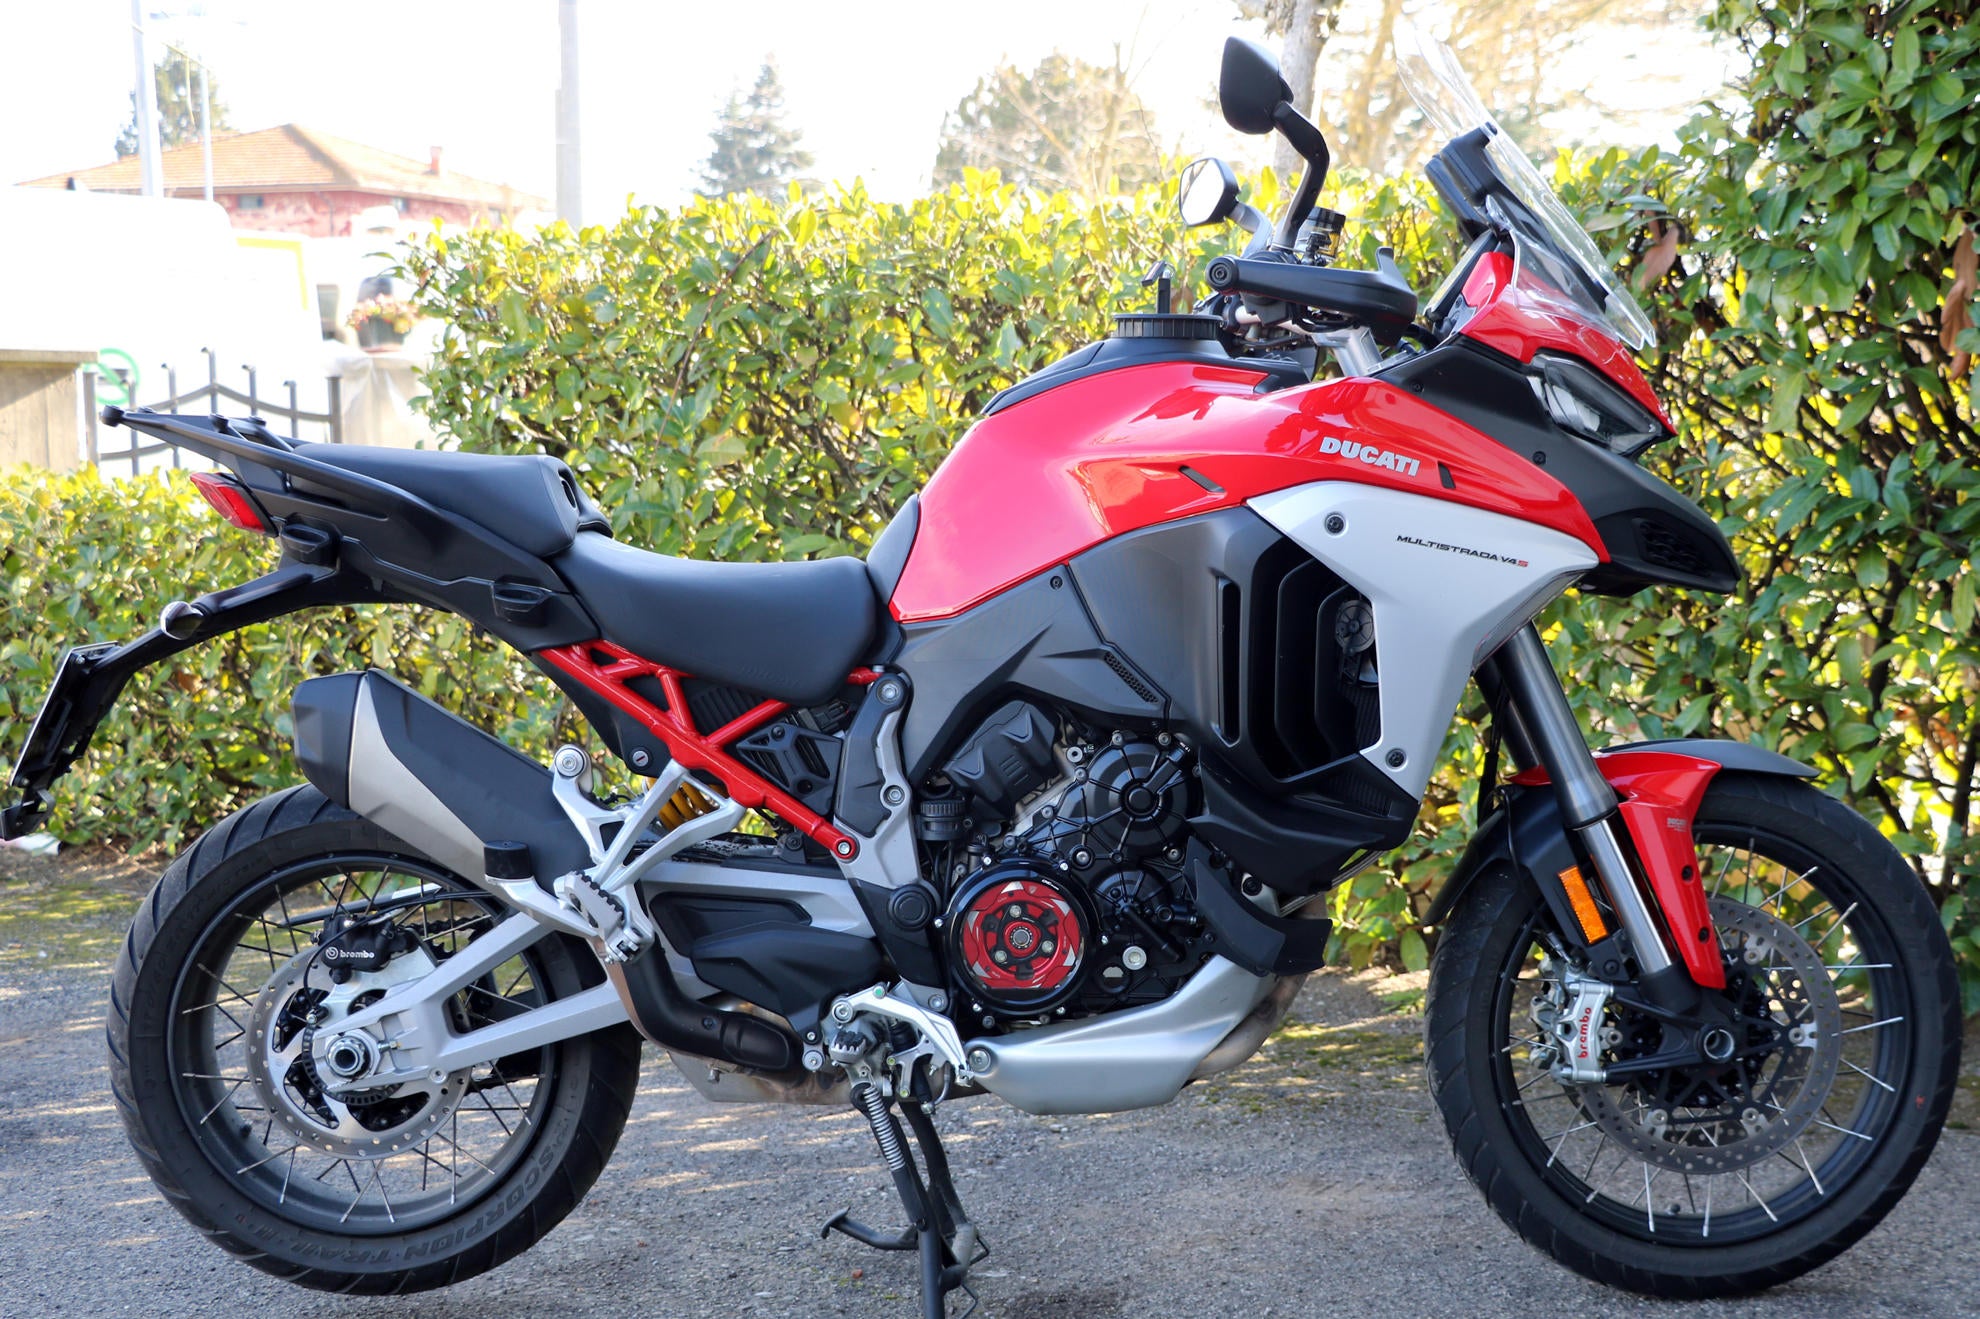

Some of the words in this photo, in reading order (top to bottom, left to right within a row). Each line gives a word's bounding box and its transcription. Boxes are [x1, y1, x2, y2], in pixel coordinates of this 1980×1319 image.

[1319, 437, 1421, 477] DUCATI
[1397, 535, 1498, 561] MULTISTRADA
[1501, 556, 1529, 568] V4S
[340, 950, 375, 959] brembo
[1577, 1007, 1592, 1059] brembo
[401, 1145, 556, 1260] SCORPION
